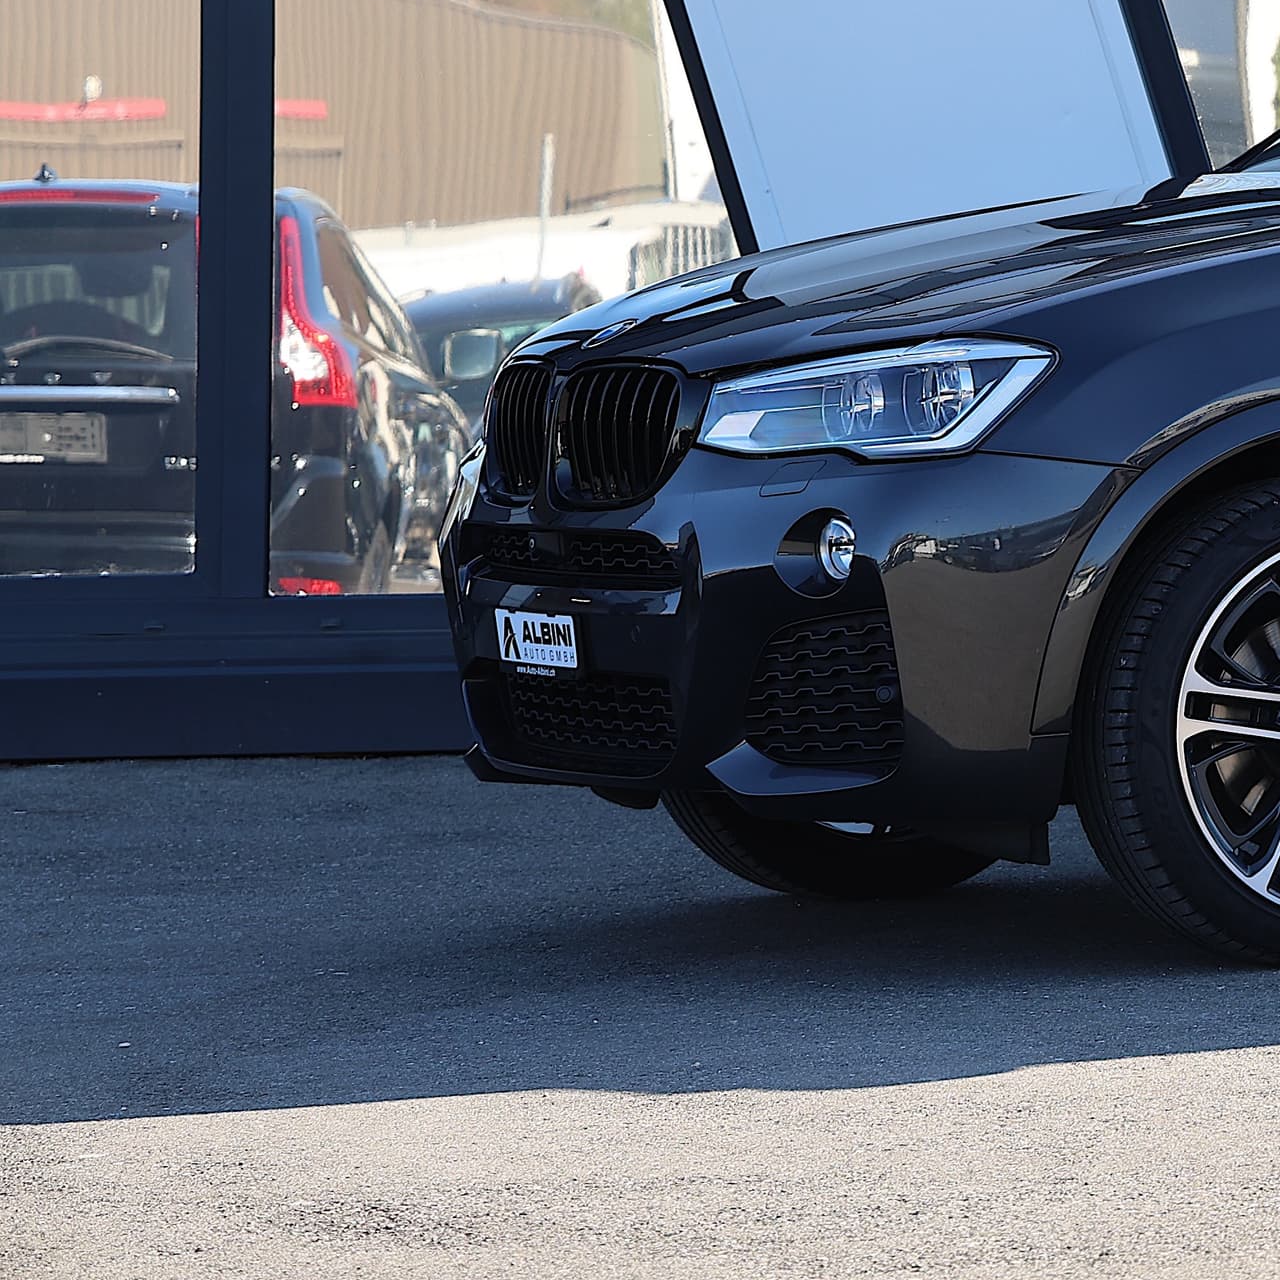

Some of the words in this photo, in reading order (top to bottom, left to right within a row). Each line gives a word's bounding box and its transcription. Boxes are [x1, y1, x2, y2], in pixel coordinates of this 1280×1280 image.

[523, 620, 573, 647] ALBINI
[524, 648, 546, 661] AUTO
[549, 650, 575, 663] GMBH
